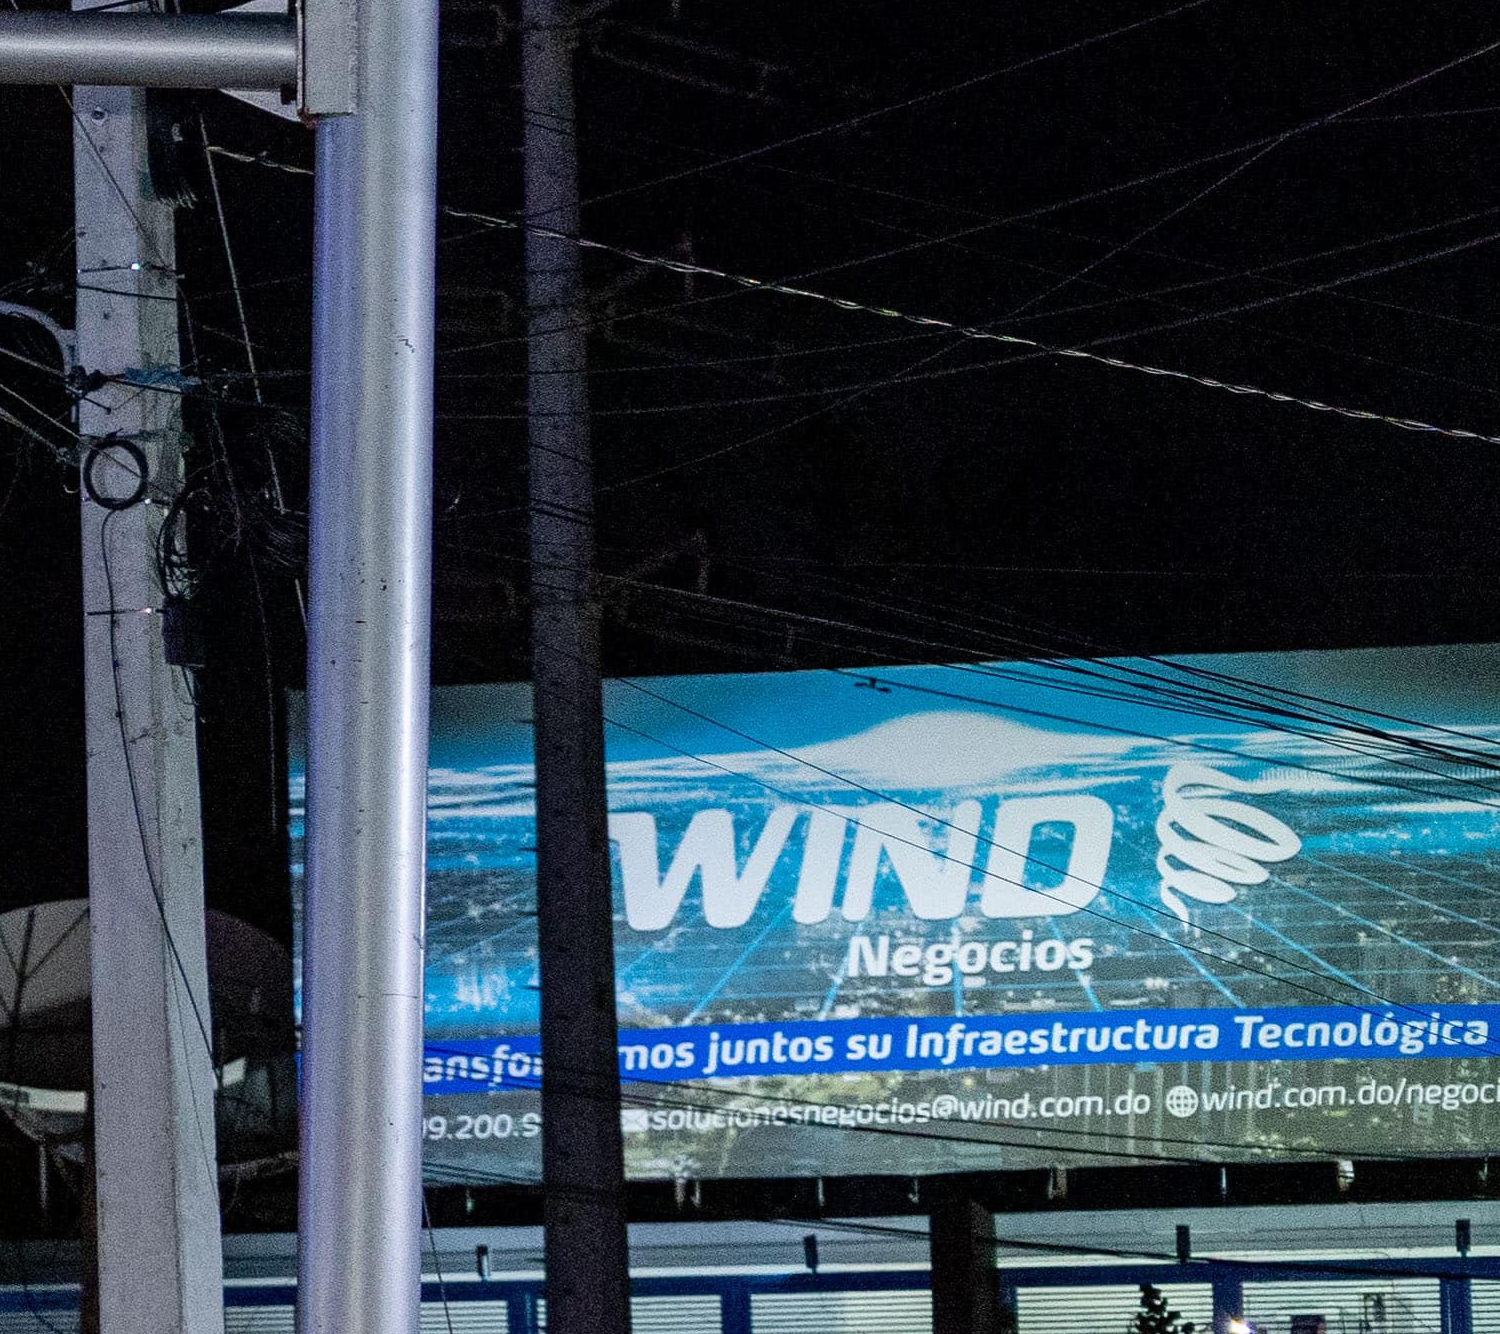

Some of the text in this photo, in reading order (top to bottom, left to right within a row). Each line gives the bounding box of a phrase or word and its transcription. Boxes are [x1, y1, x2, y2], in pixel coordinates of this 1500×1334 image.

[608, 794, 1114, 932] WIND
[846, 930, 1095, 987] Negocios
[702, 1031, 834, 1074] juntos
[845, 1031, 892, 1062] su
[905, 1018, 1220, 1065] Infraestructura
[1233, 1011, 1489, 1055] Tecnológica
[650, 1088, 1151, 1132] solucionesnegocios@wind.com.do
